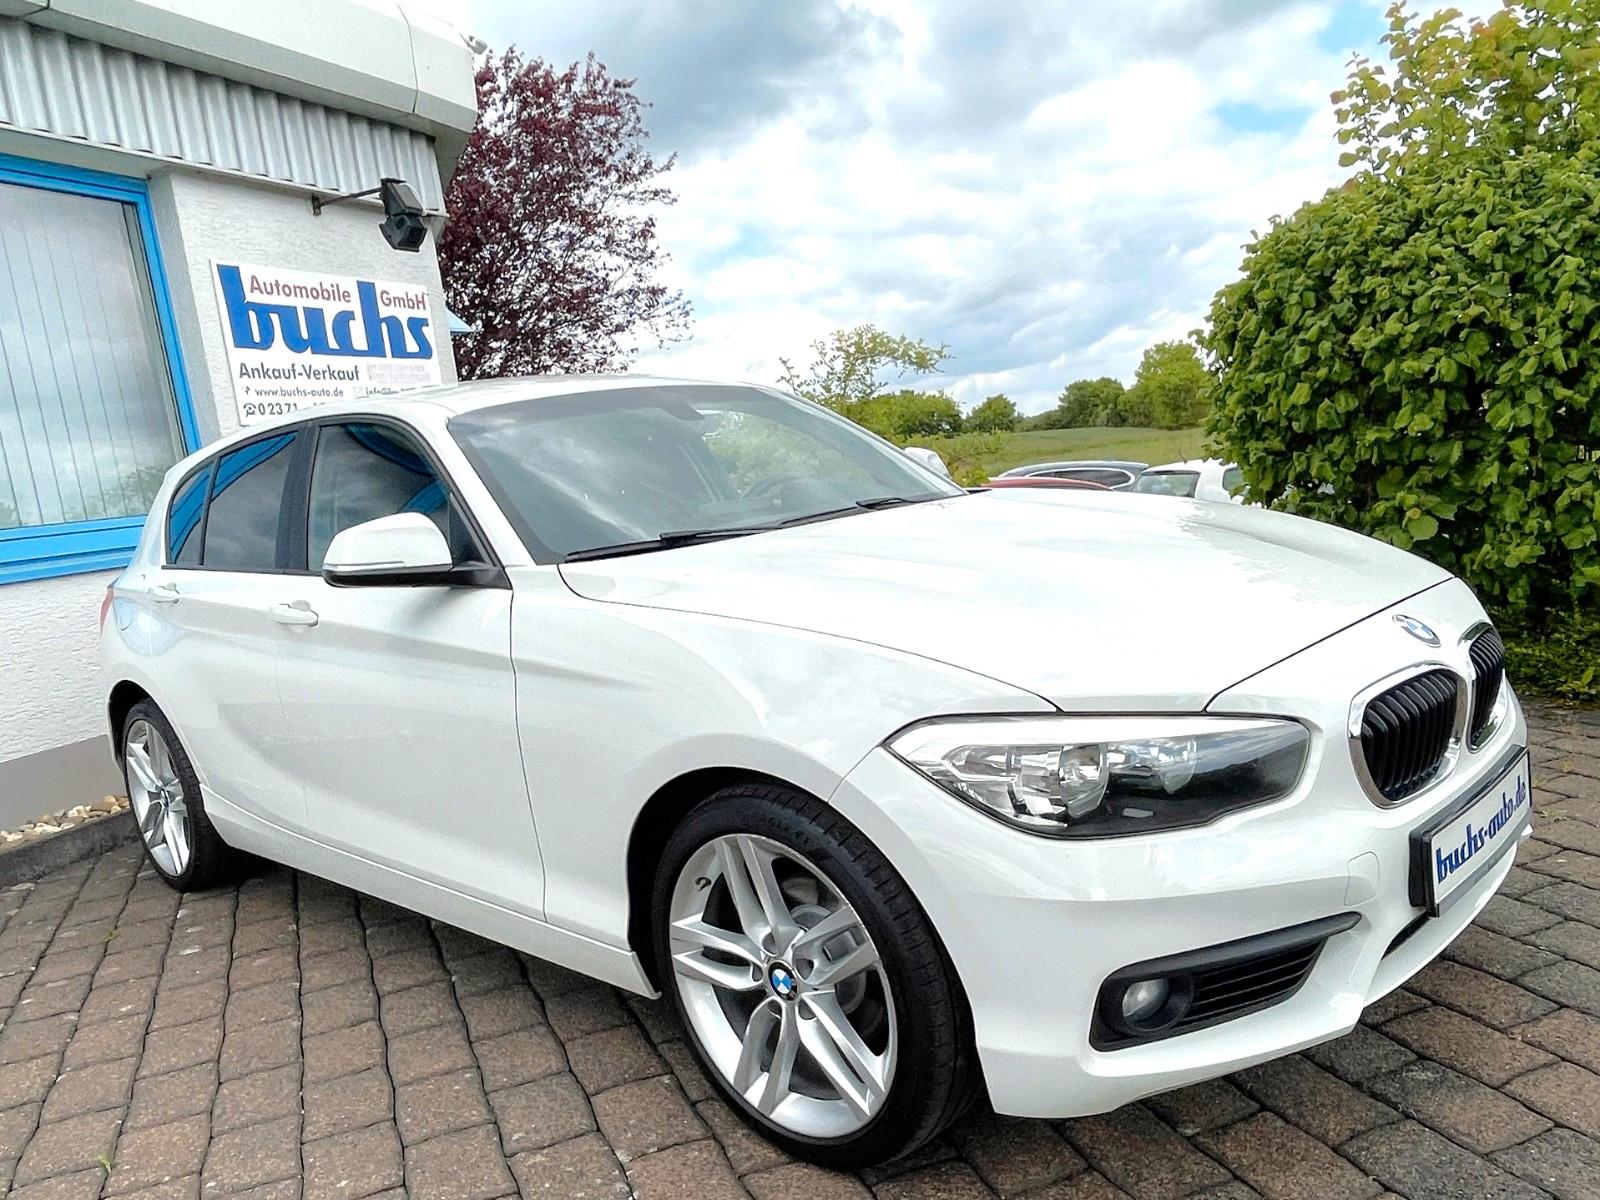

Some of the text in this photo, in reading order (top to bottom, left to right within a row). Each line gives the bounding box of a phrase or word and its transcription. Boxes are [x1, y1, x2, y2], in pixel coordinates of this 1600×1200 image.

[249, 275, 352, 303] Automobile
[380, 289, 427, 311] GmbH
[216, 263, 433, 360] buchs
[239, 362, 360, 381] Ankauf-Verkauf
[254, 386, 344, 397] www.buchs-auto.de
[1435, 775, 1526, 884] buchs-auto.de
